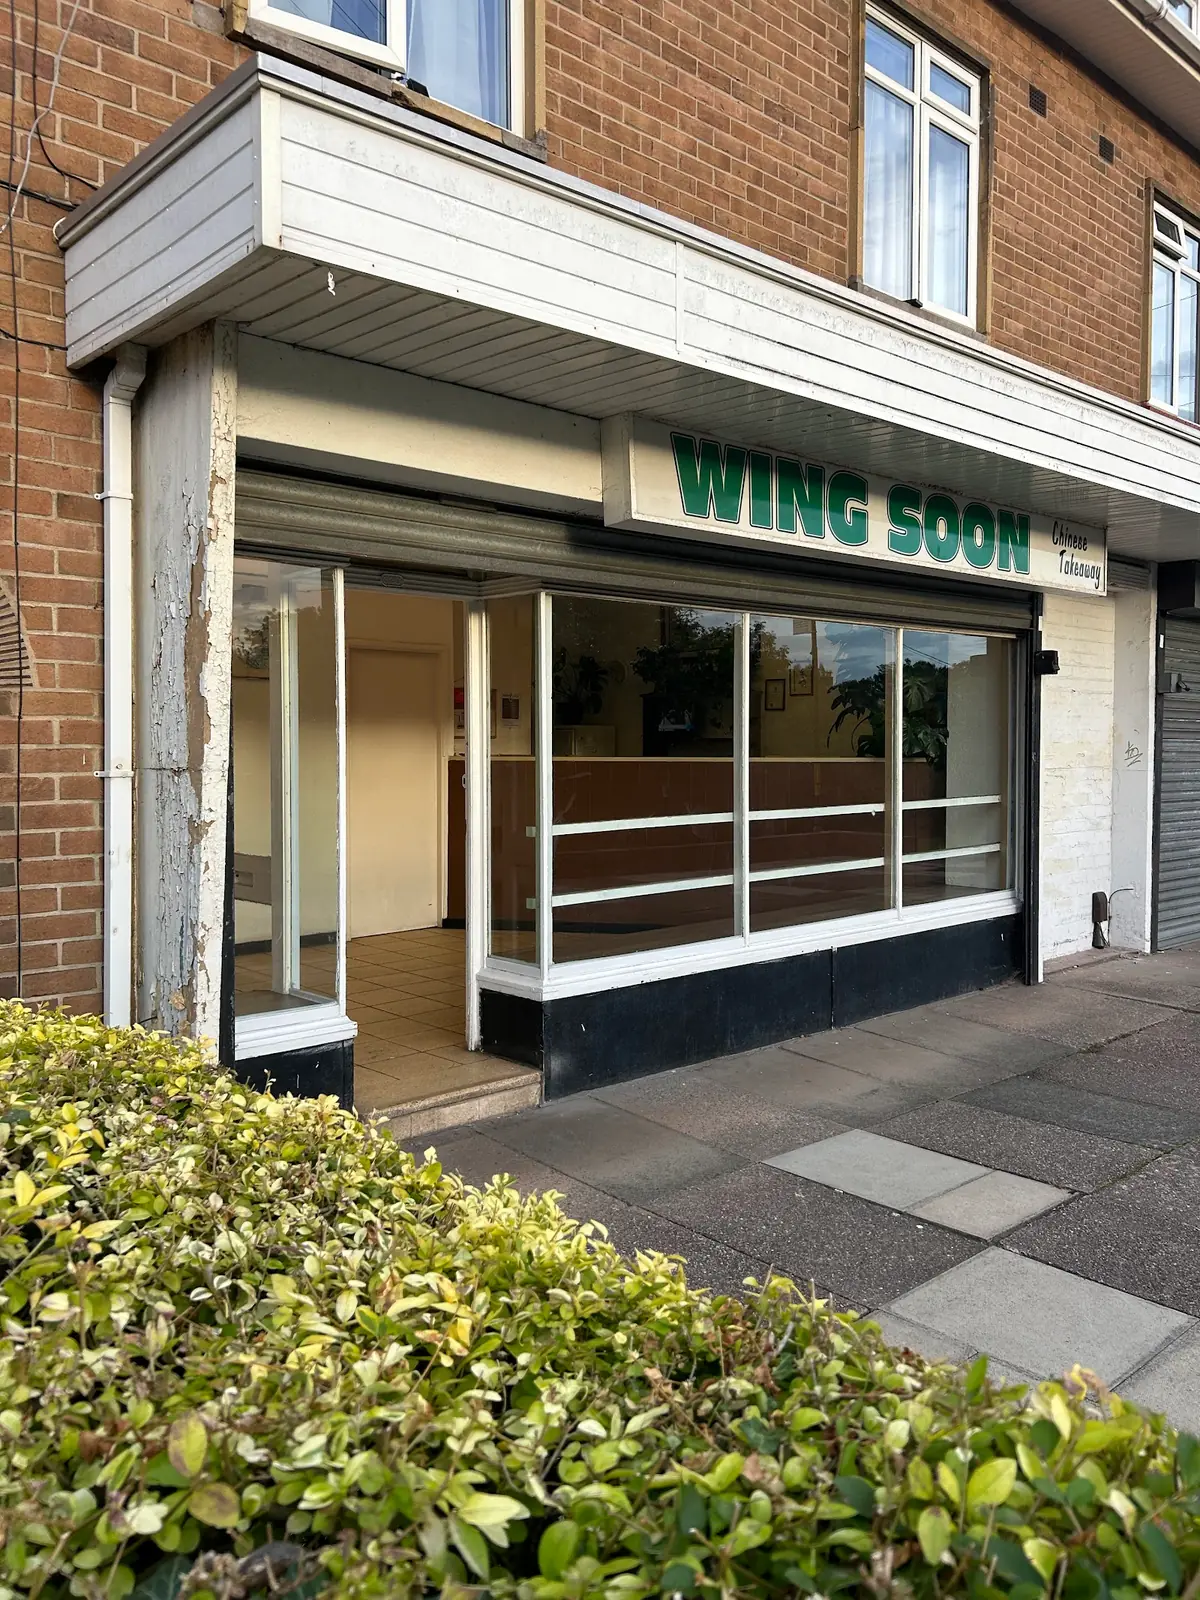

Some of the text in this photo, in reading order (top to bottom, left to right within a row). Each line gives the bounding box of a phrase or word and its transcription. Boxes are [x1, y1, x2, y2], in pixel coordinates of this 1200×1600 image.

[670, 431, 1030, 574] WING SOON
[1052, 520, 1088, 551] Chinese
[1059, 549, 1101, 589] Takeaway
